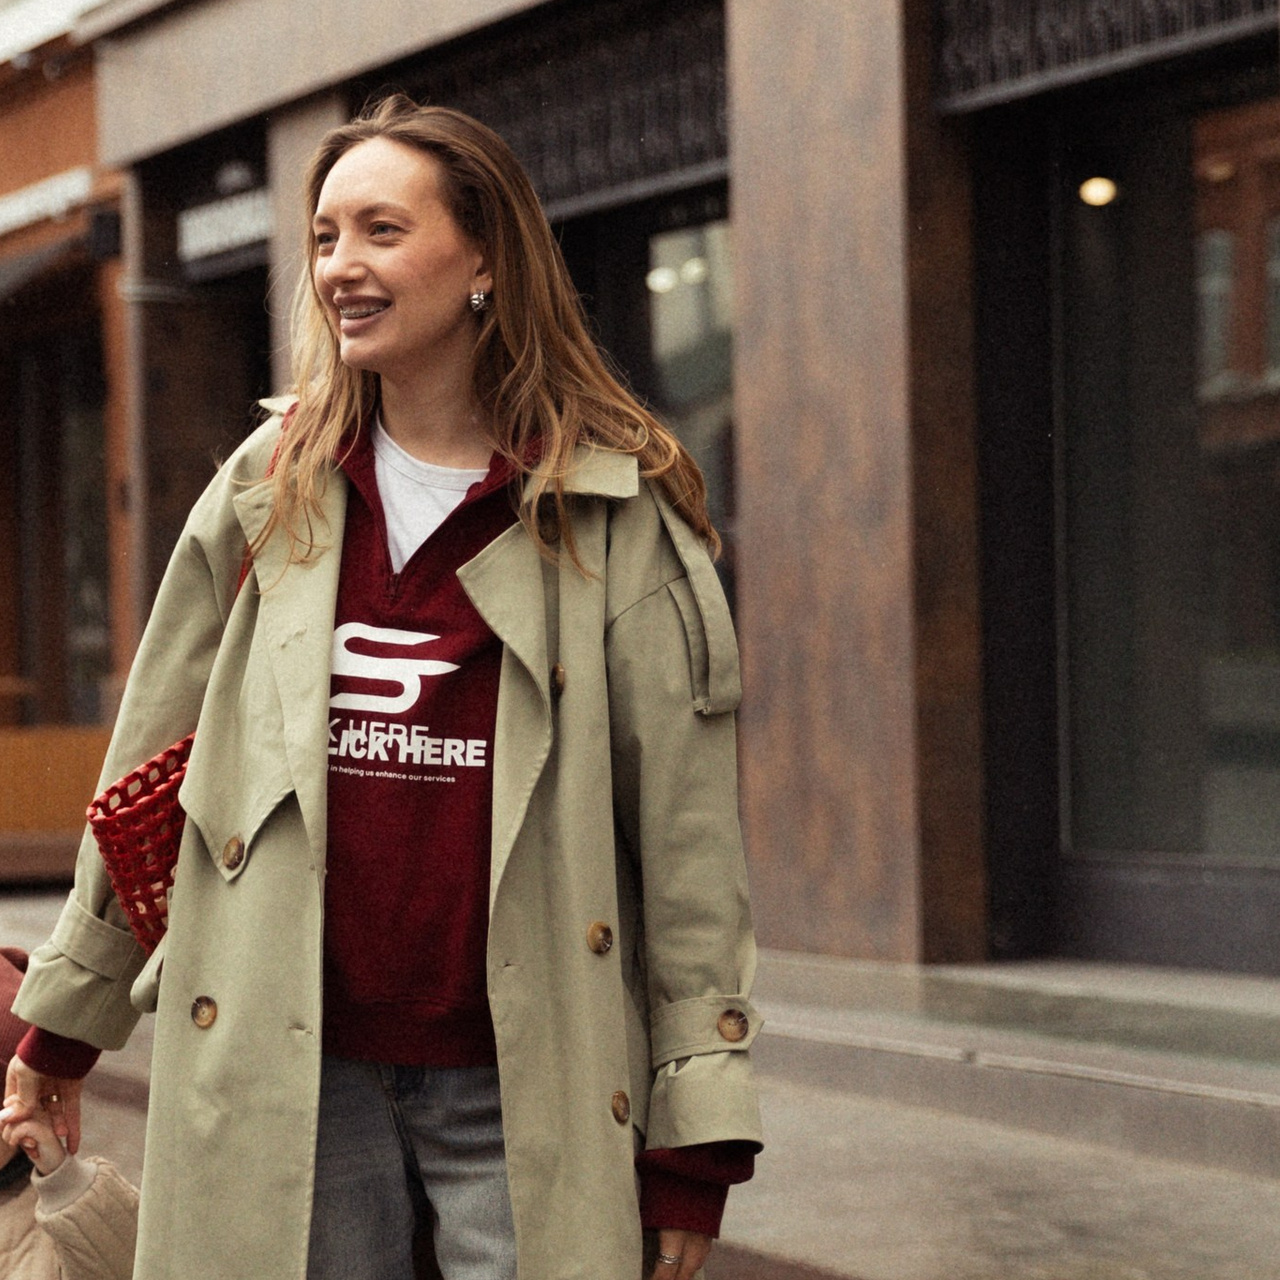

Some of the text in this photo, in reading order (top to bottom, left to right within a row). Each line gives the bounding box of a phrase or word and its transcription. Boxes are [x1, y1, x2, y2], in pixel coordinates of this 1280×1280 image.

[398, 734, 487, 767] HERE
[339, 765, 364, 777] helping
[375, 771, 407, 780] enhance
[423, 775, 456, 783] services
